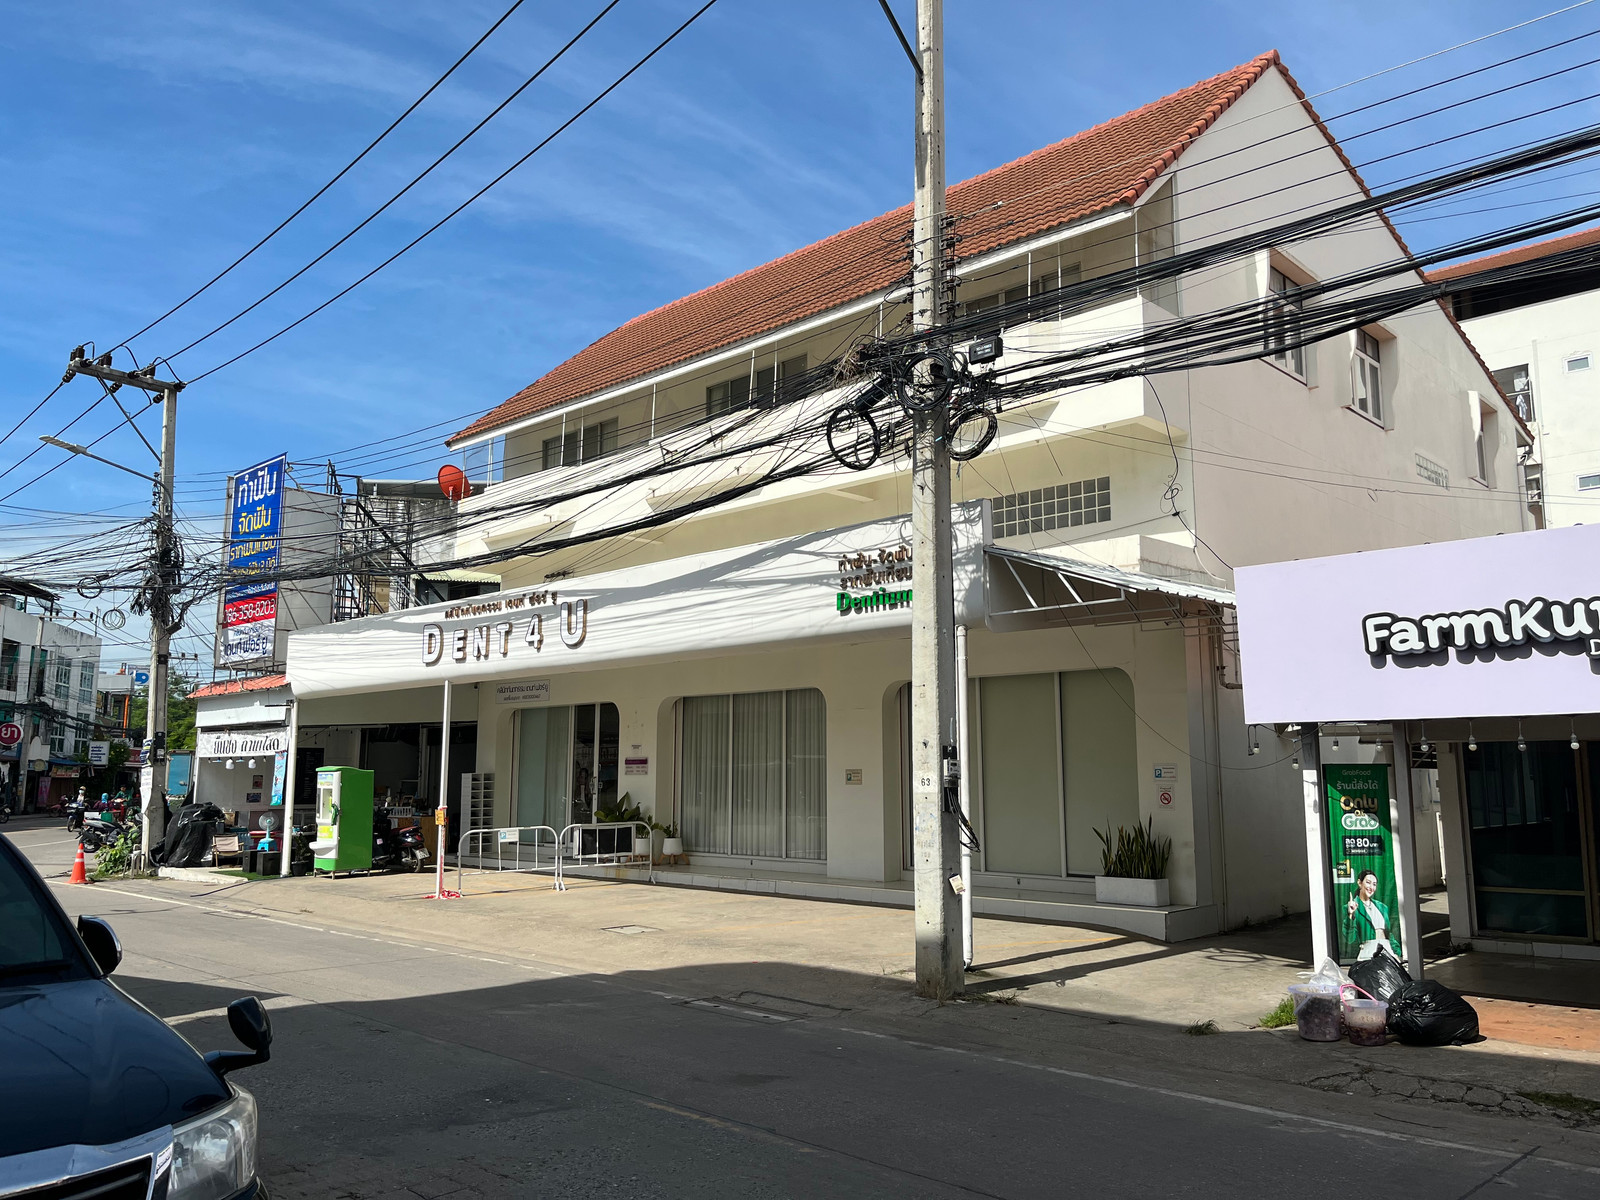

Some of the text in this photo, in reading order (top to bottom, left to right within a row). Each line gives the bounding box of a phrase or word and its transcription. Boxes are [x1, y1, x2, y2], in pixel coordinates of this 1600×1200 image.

[237, 466, 277, 508] ทำฟัน
[238, 504, 272, 535] จัดฟัน
[223, 598, 276, 624] 086-358-8203
[423, 599, 588, 665] DENT 4 U
[1, 727, 18, 738] ยา
[920, 778, 931, 786] 63
[1336, 778, 1379, 790] ร้านนี้สั่งได้
[1340, 794, 1379, 812] Only
[1344, 815, 1378, 828] Grab
[1356, 837, 1370, 848] 80
